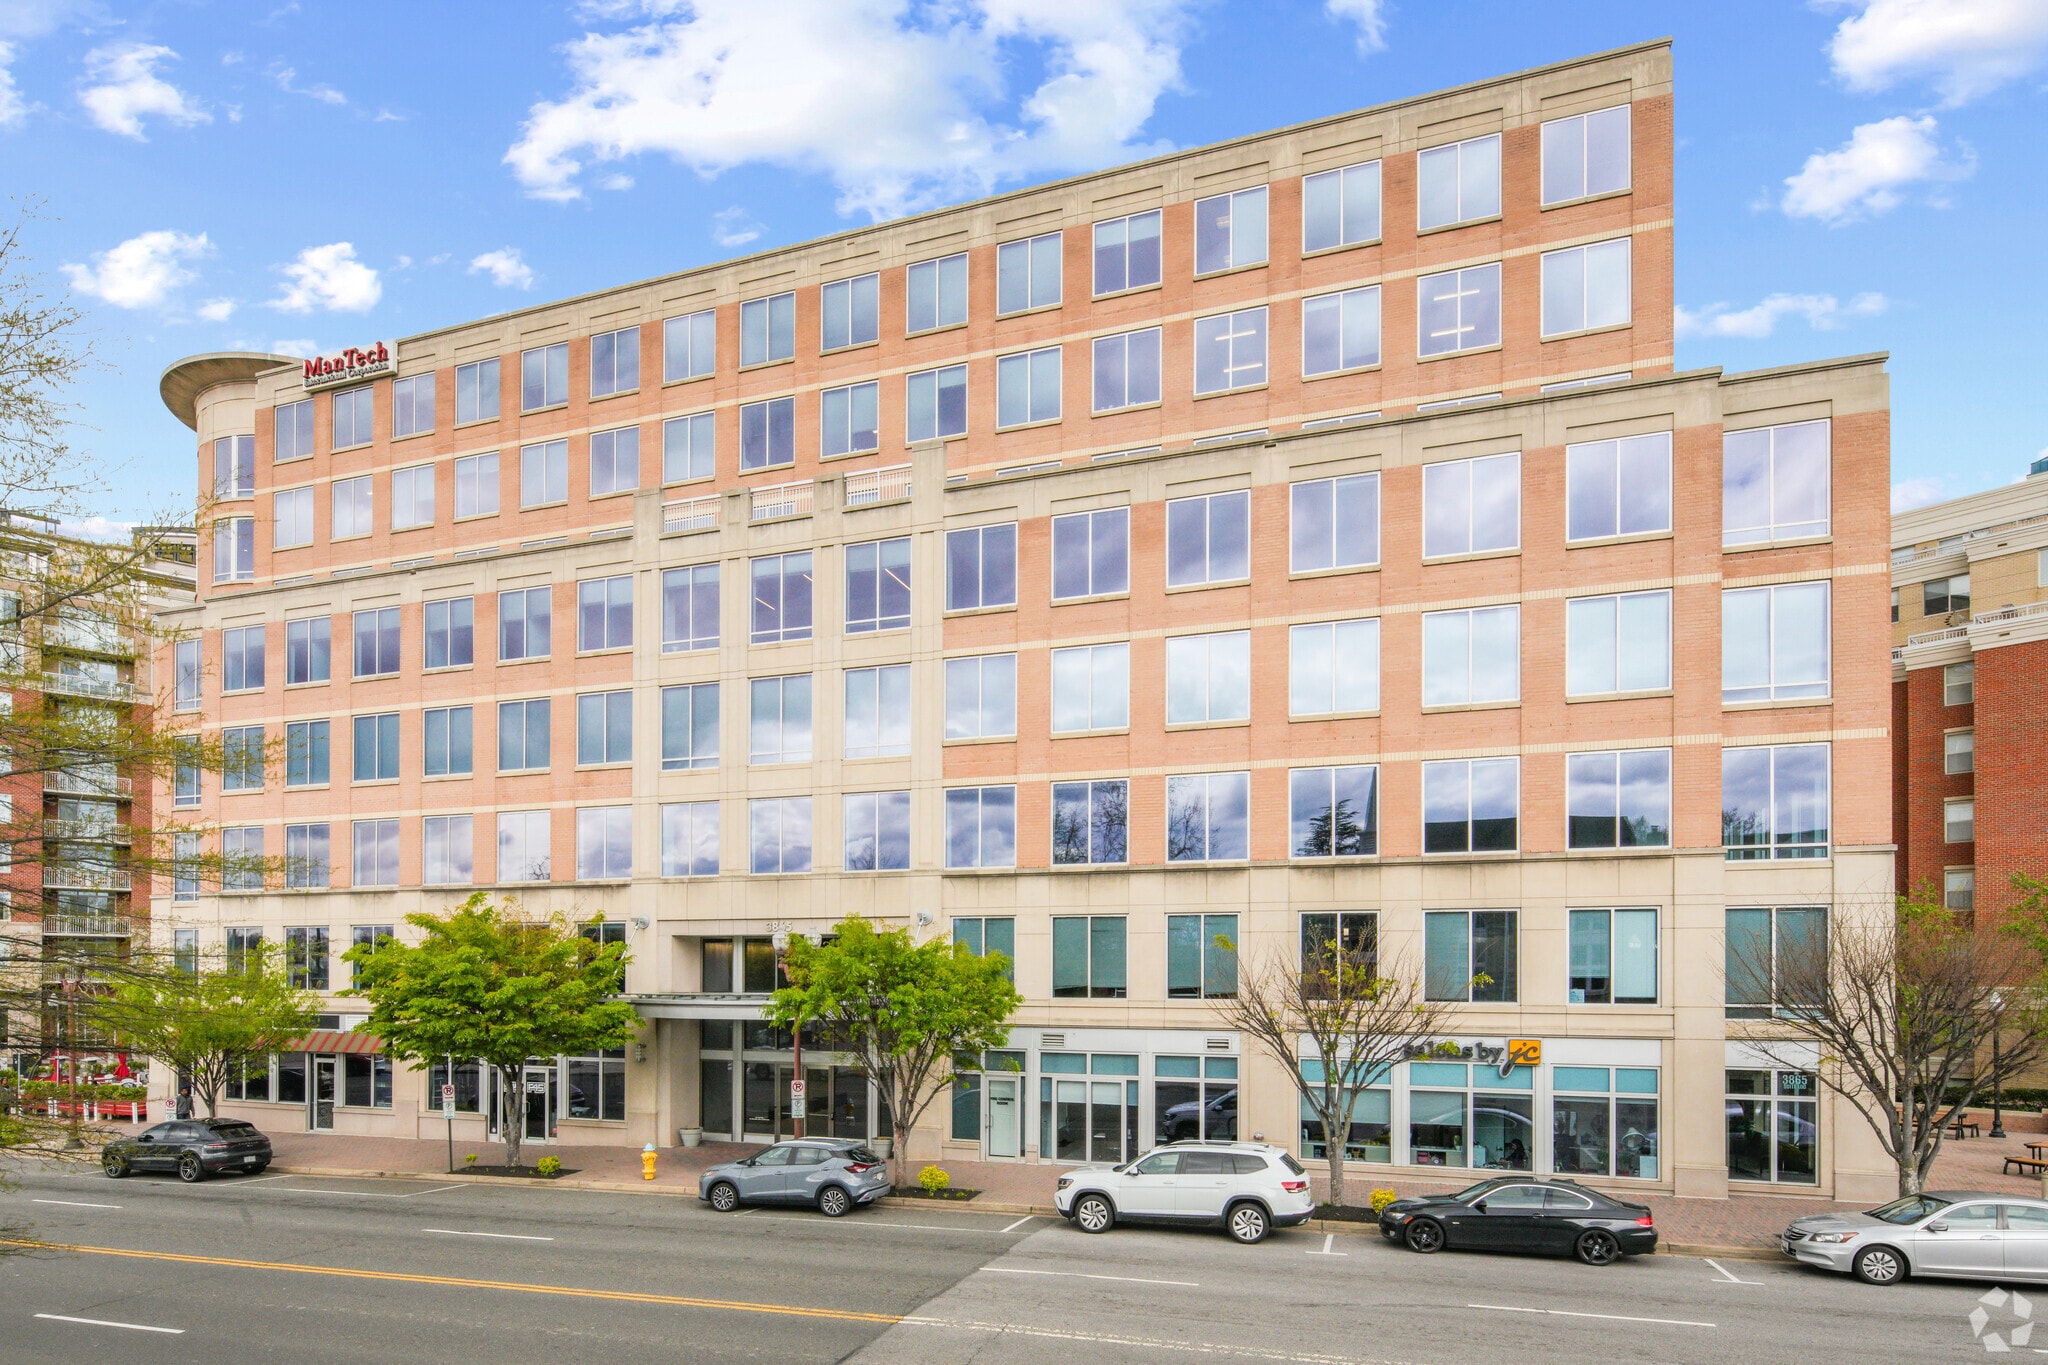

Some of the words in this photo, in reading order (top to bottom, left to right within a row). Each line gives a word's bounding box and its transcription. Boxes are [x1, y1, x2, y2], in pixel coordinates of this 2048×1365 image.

[303, 341, 389, 378] ManTech
[766, 921, 793, 932] 385
[1476, 1042, 1504, 1064] by
[1782, 1075, 1808, 1085] 3865
